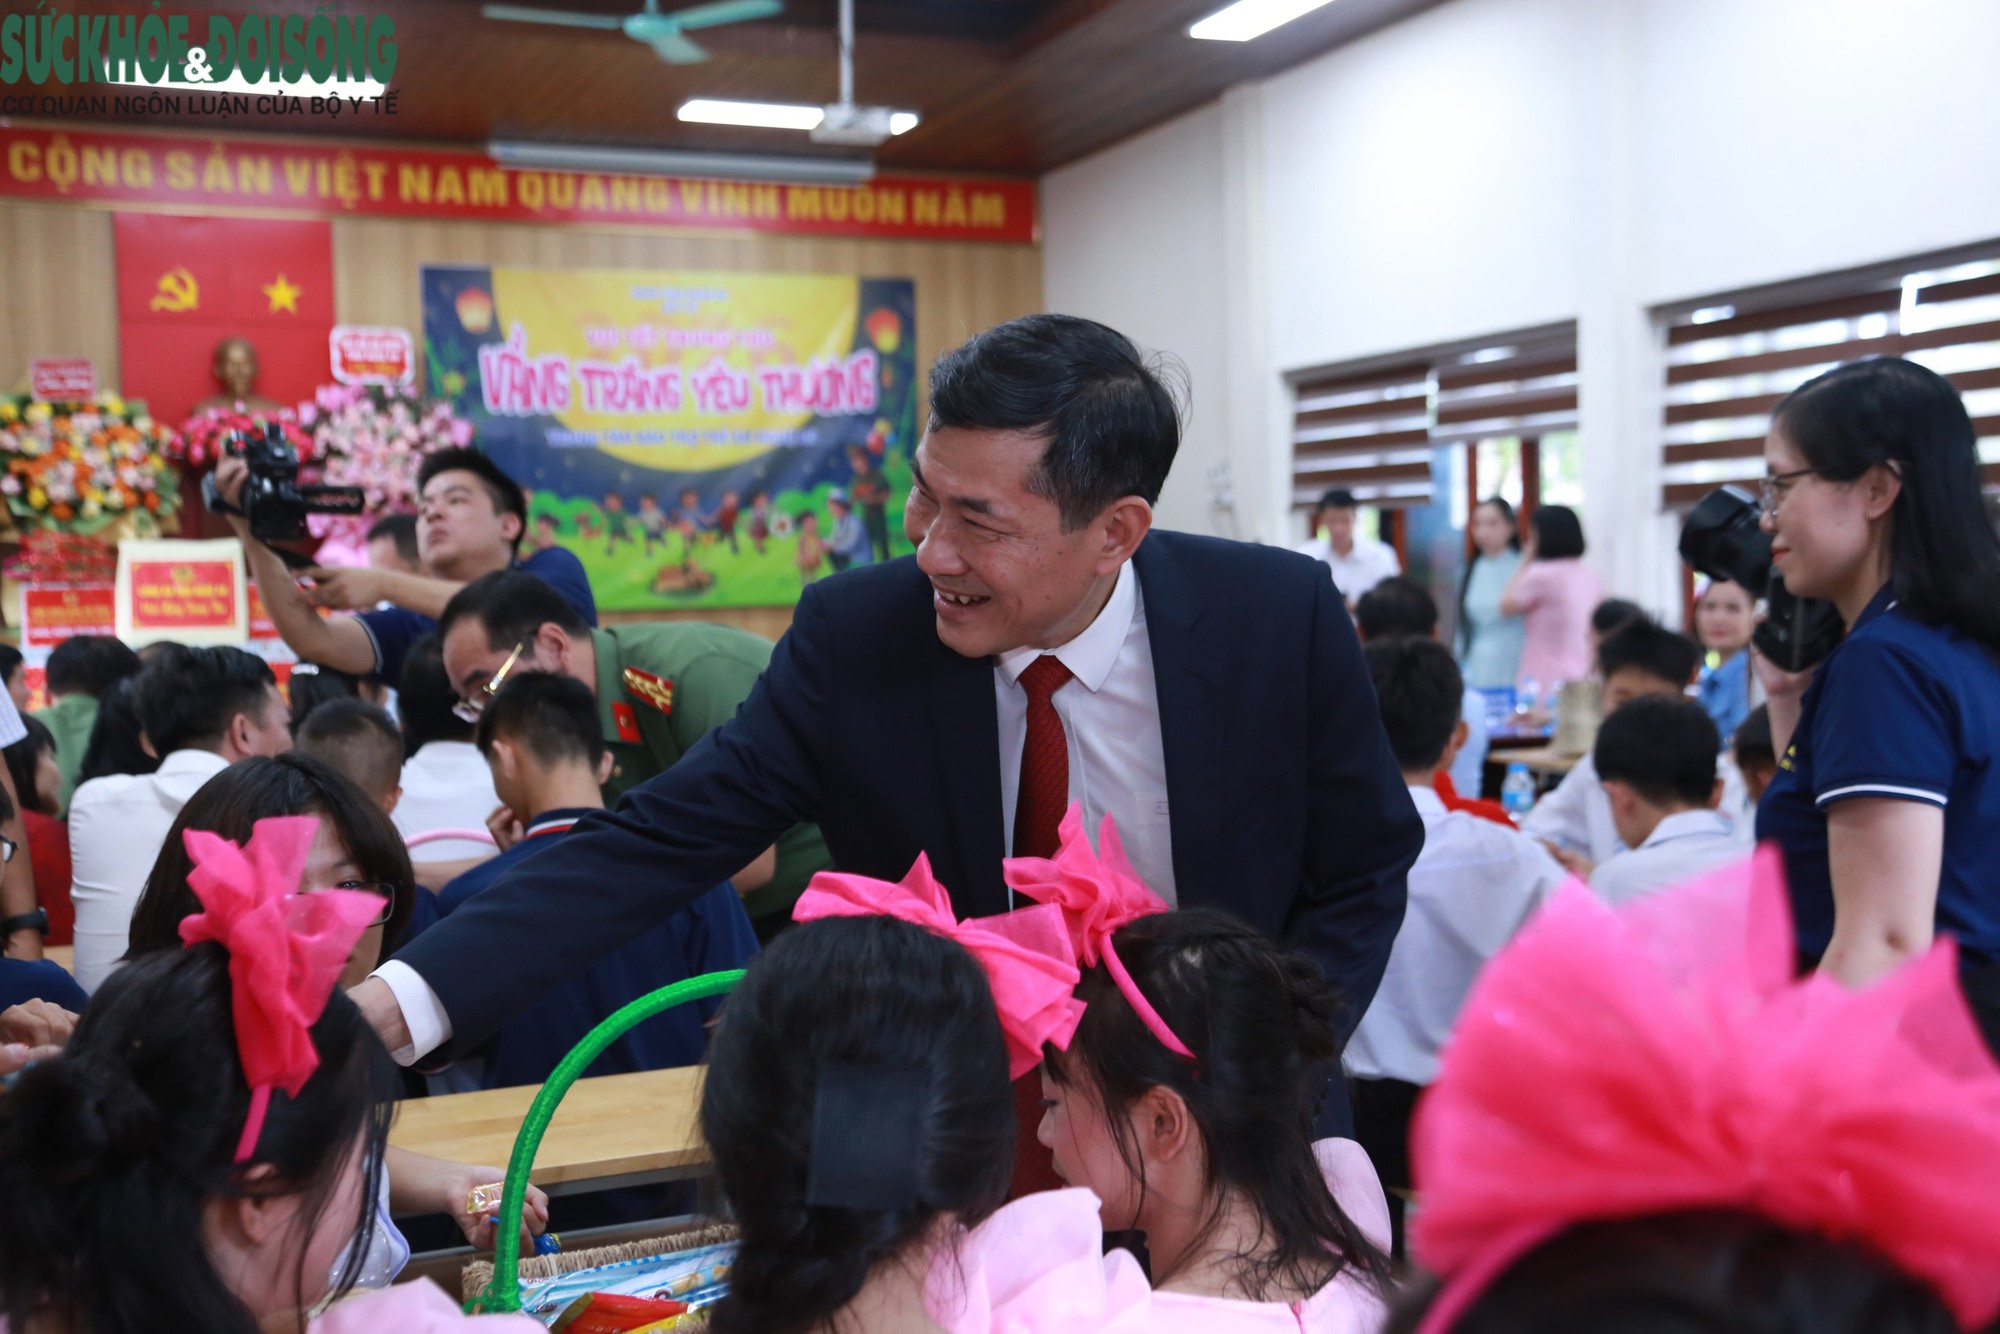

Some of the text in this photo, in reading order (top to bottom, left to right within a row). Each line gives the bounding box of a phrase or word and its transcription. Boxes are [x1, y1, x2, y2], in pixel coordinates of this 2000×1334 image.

[8, 134, 153, 194] CỘNG
[164, 140, 271, 196] SẢN
[284, 149, 387, 209] VIỆT
[399, 163, 507, 207] NAM
[516, 170, 671, 213] QUANG
[679, 176, 779, 219] VINH
